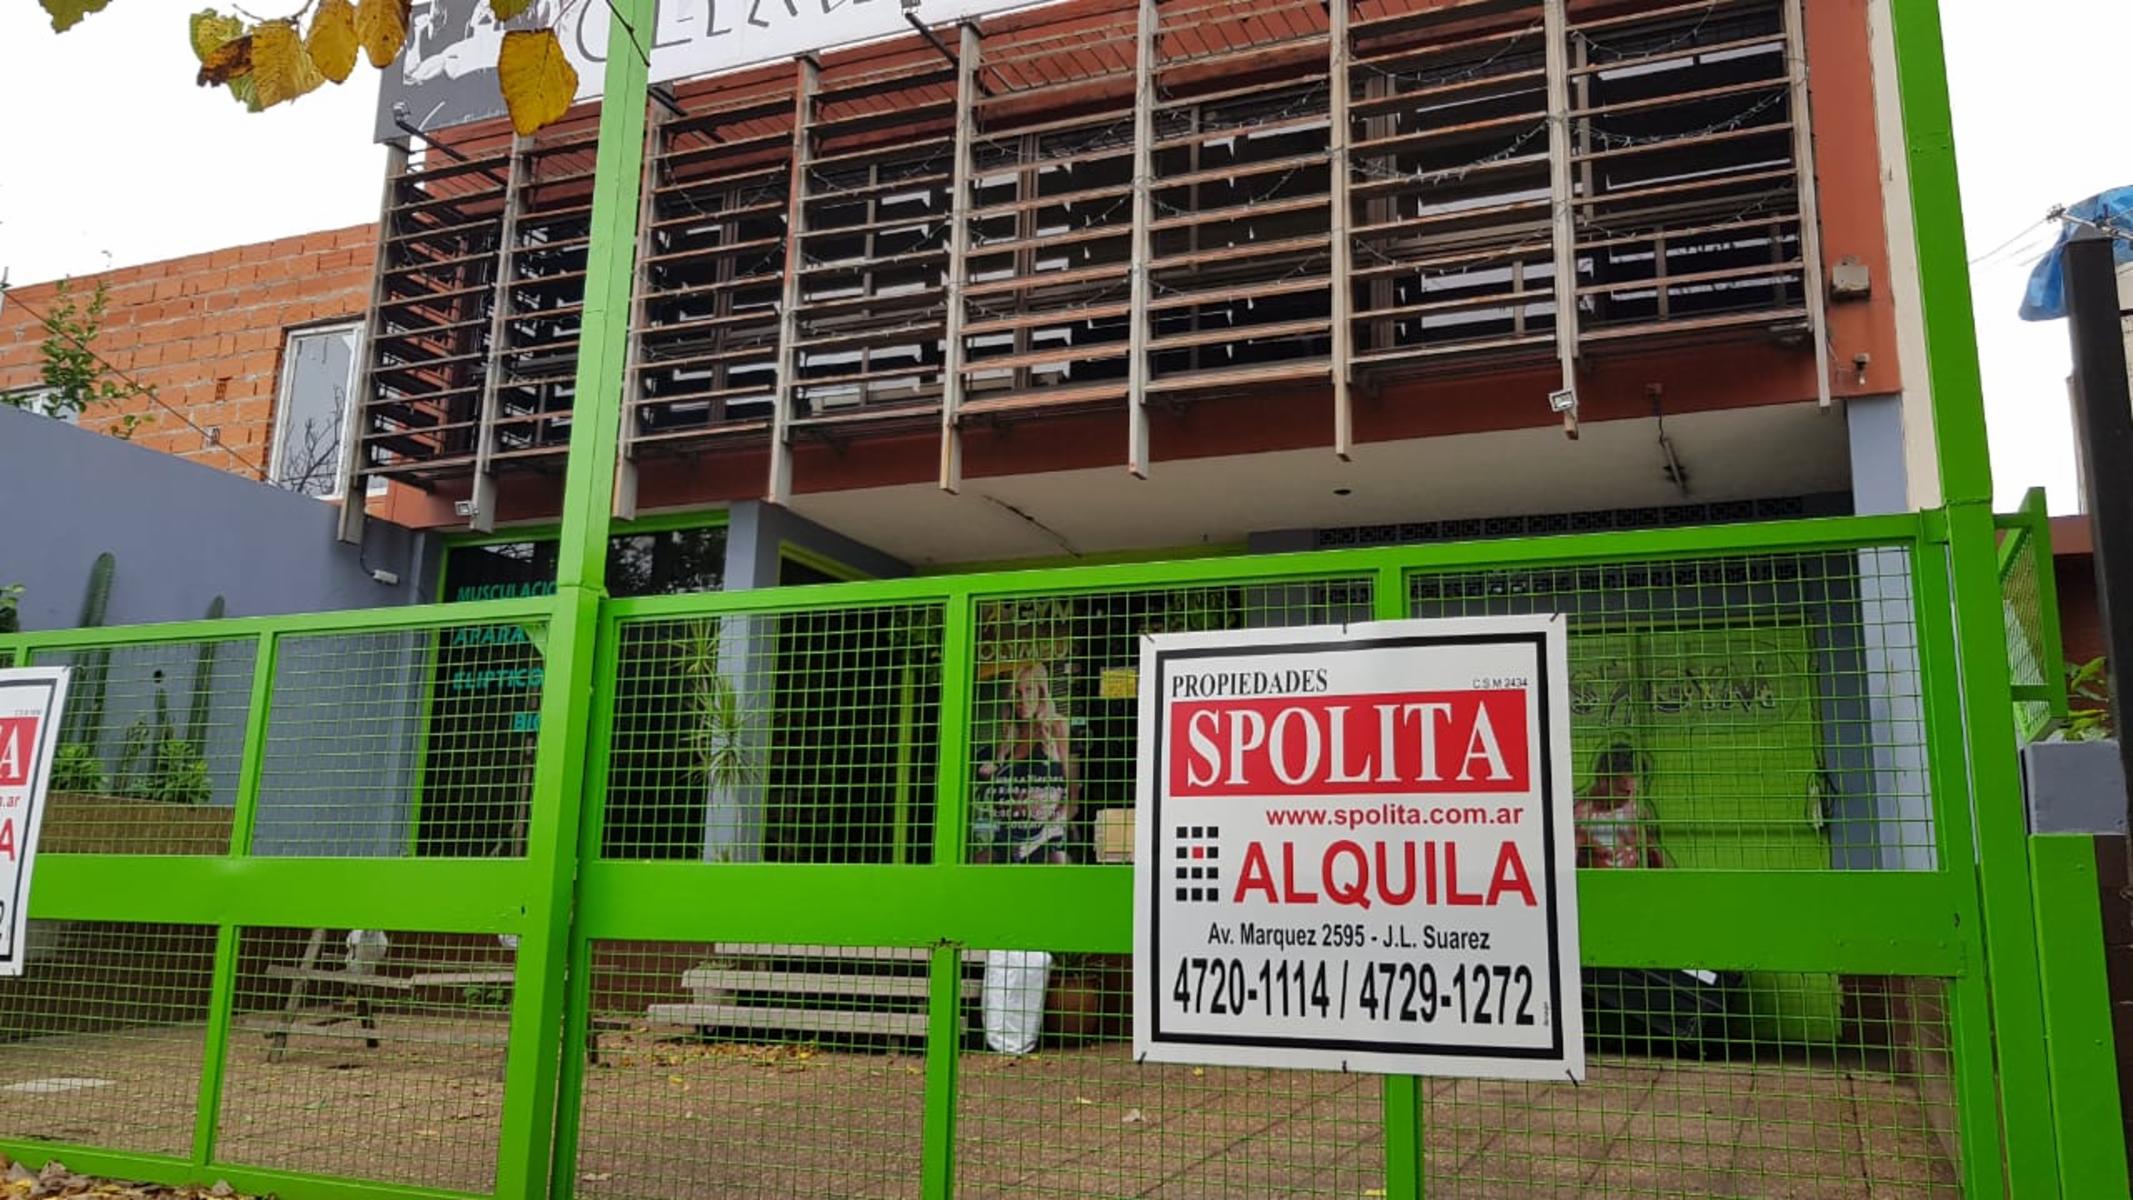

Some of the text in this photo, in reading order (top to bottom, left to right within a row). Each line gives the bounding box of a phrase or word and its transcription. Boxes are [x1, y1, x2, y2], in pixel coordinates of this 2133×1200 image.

[1171, 669, 1328, 698] PROPIEDADES
[1187, 700, 1514, 788] SPOLITA
[1265, 803, 1525, 830] www.spolita.com.ar
[1232, 839, 1539, 910] ALQUILA
[1207, 922, 1234, 945] Av.
[1240, 923, 1317, 951] Marquez
[1321, 924, 1366, 948] 2595
[1382, 926, 1418, 949] J.L.
[1423, 926, 1491, 950] Suarez
[1173, 956, 1331, 1018] 4720-1114
[1339, 959, 1349, 1020] /
[1358, 961, 1535, 1026] 4729-1272
